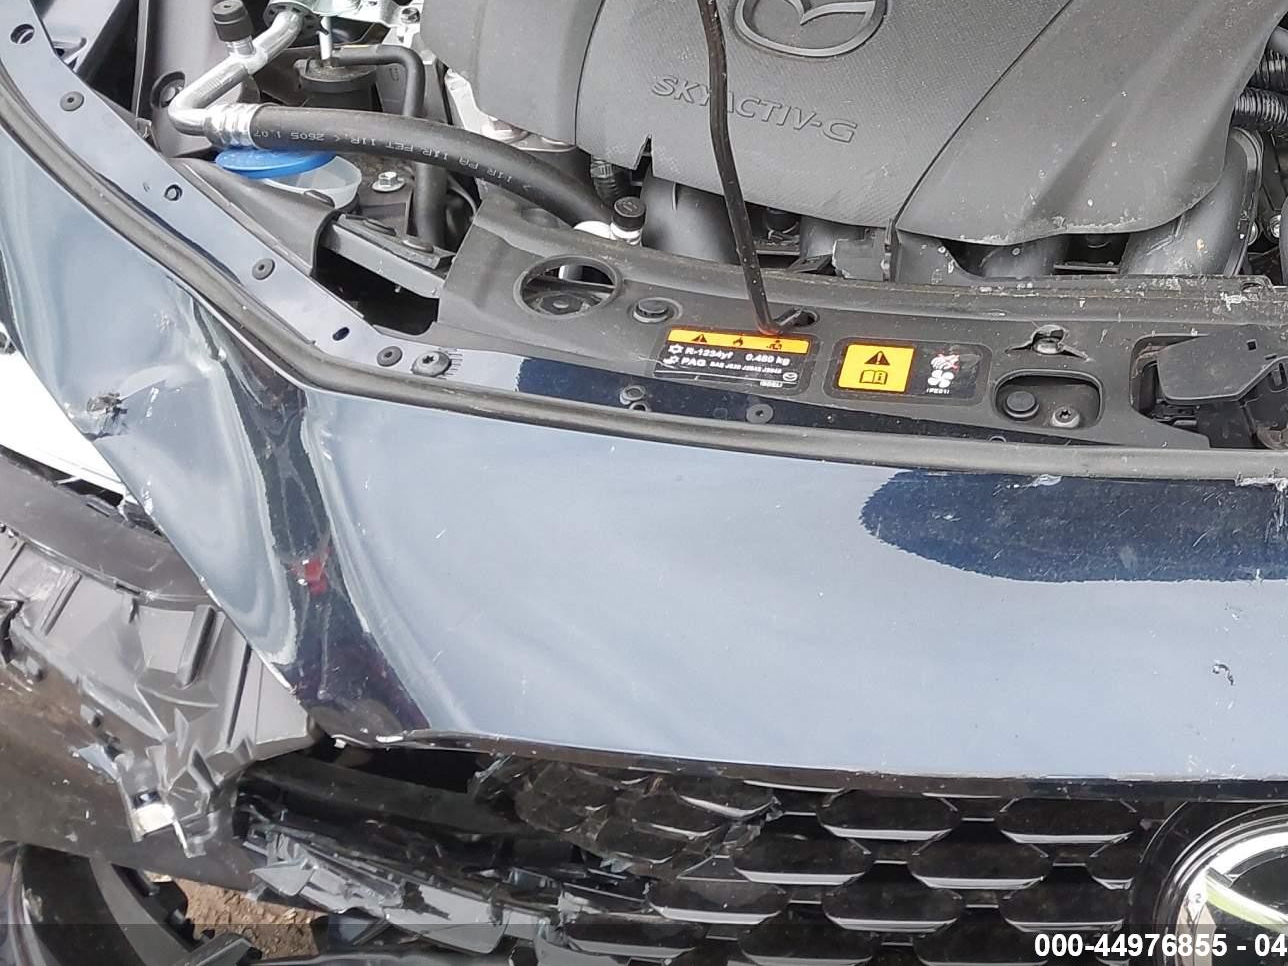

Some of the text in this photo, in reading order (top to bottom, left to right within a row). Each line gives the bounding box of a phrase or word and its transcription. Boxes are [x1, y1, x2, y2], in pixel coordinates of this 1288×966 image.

[681, 357, 707, 367] PAG
[684, 347, 734, 360] R-1234yf
[776, 354, 791, 366] kg
